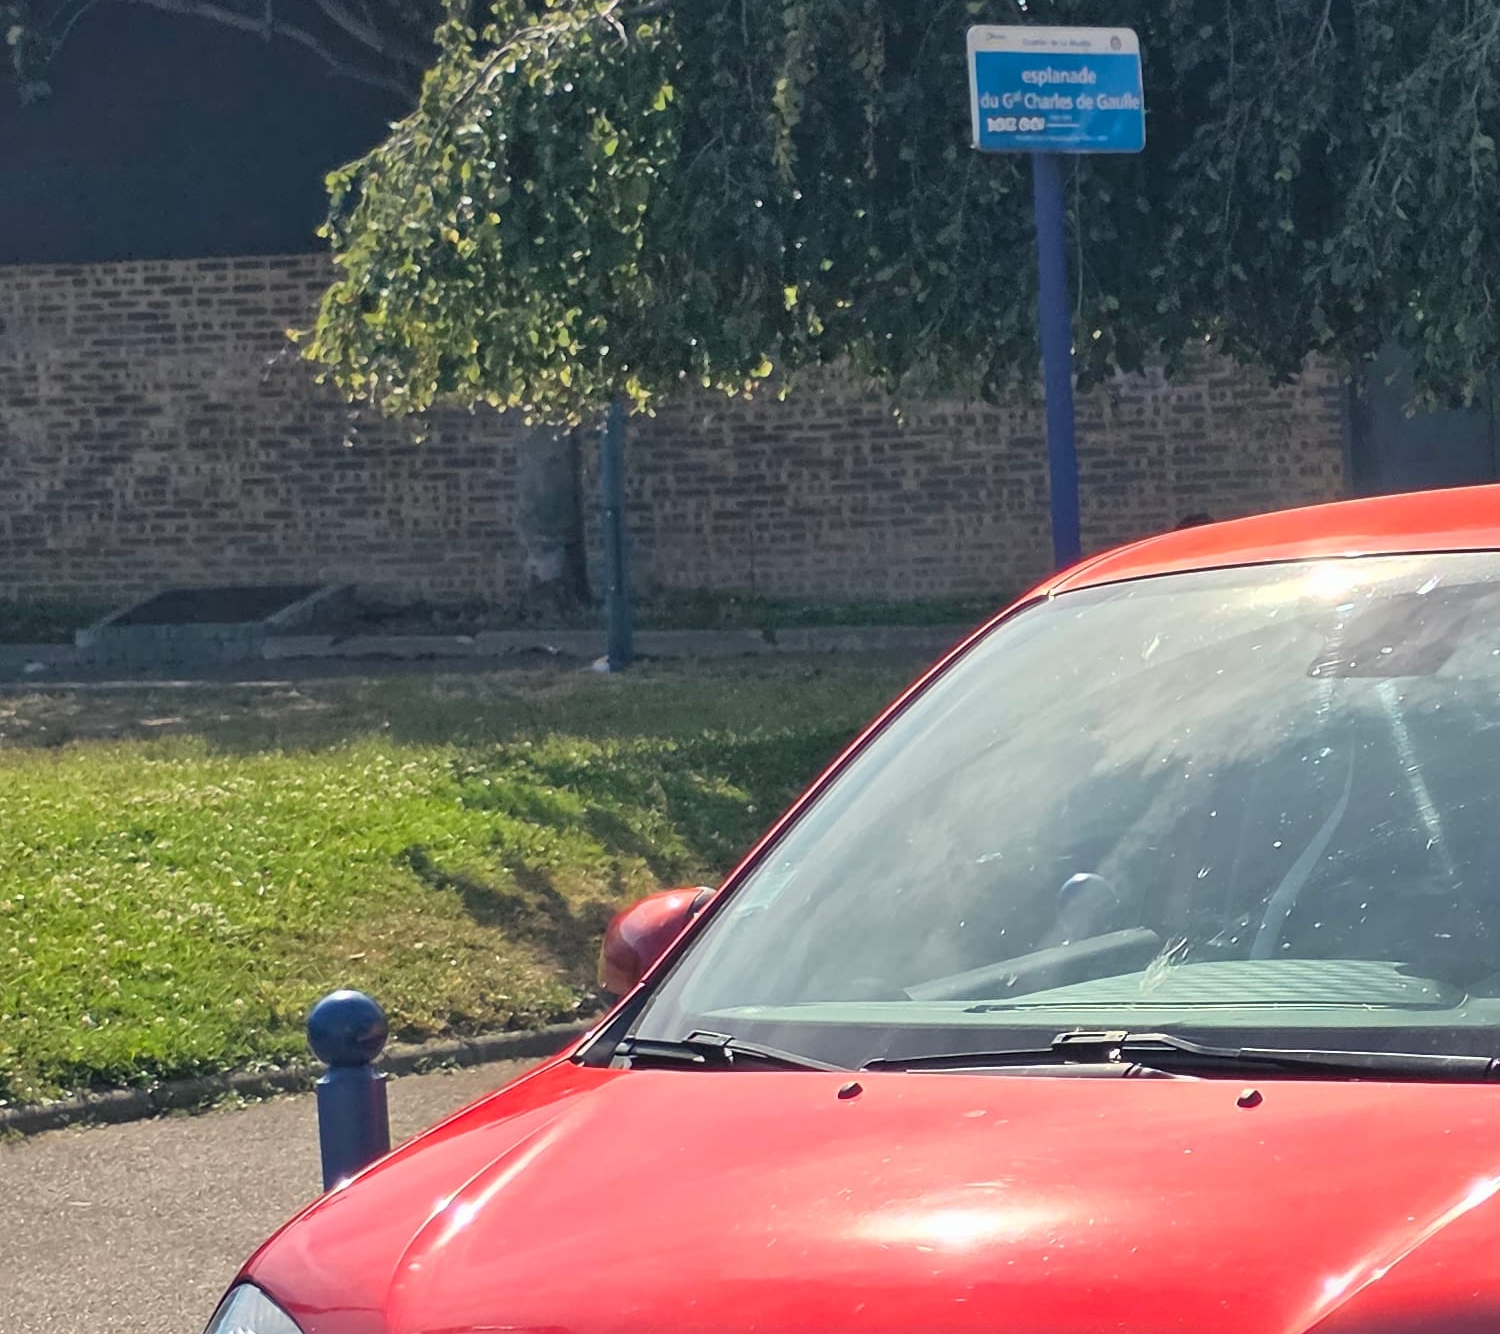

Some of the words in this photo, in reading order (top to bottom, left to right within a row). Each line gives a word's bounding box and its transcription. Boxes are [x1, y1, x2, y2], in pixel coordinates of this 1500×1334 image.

[1022, 66, 1096, 87] esplanade
[980, 92, 998, 108] du
[1023, 92, 1073, 109] Charles
[1076, 93, 1093, 109] de
[1096, 93, 1141, 110] Gaulle
